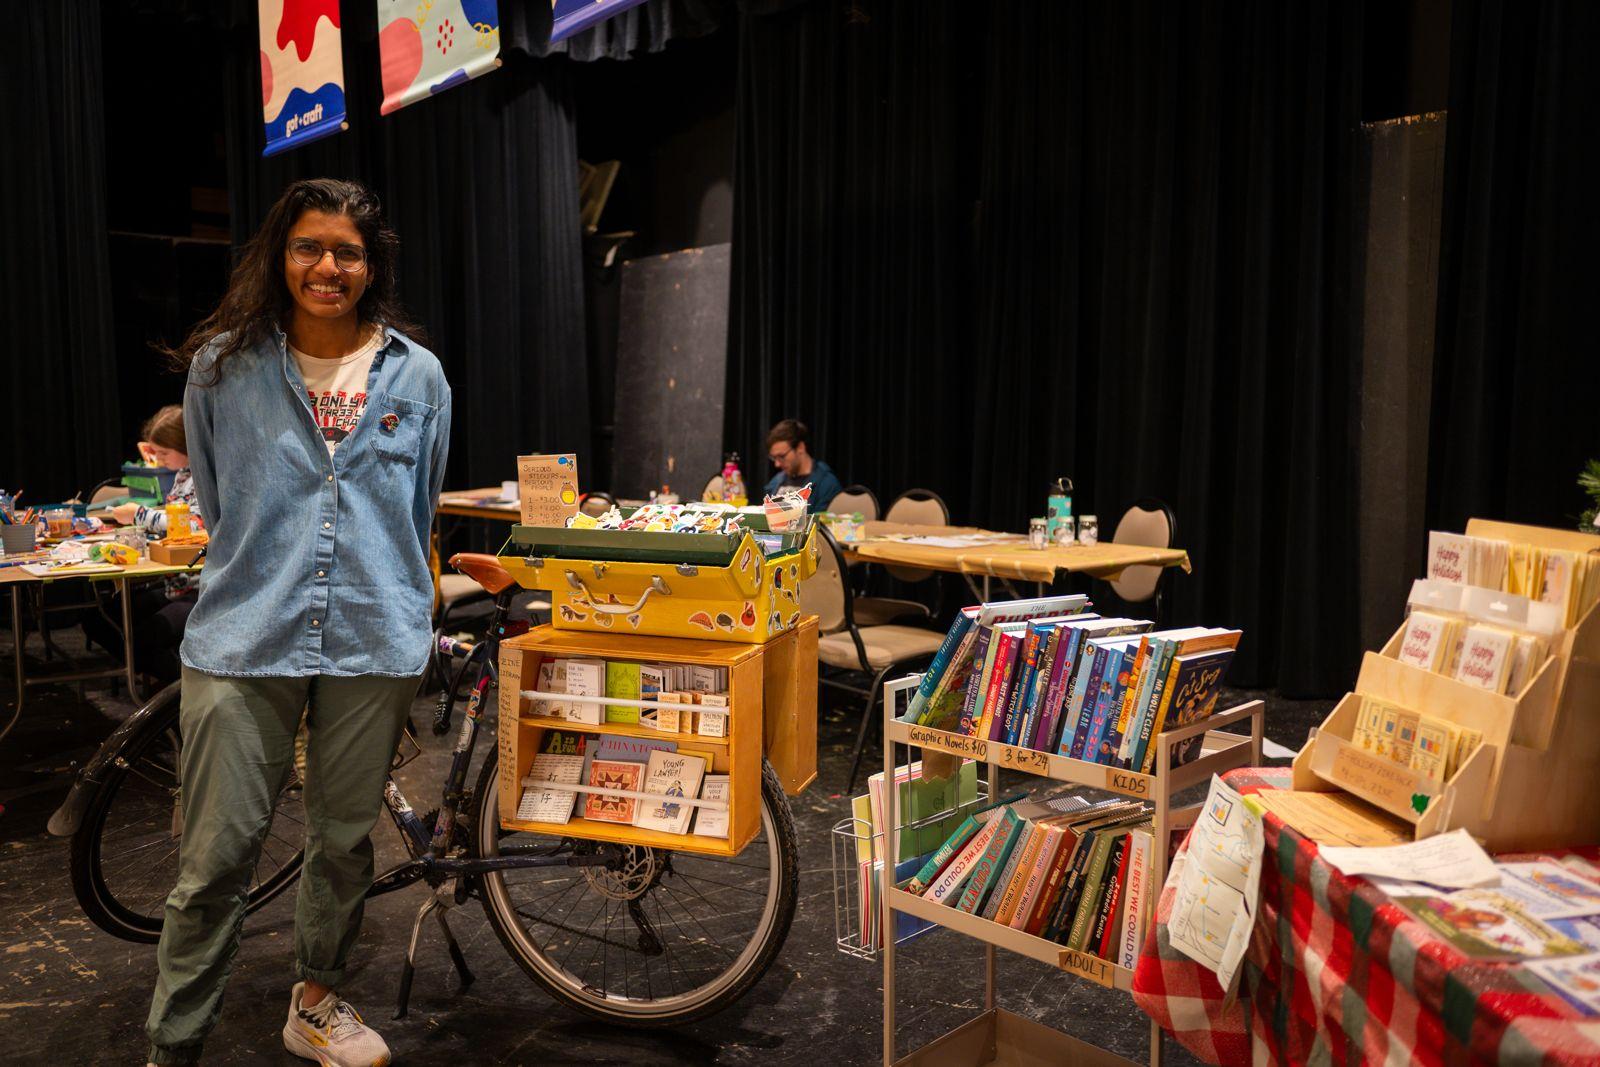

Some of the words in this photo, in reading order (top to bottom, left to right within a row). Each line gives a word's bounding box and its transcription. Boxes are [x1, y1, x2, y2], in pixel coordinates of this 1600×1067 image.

[286, 114, 298, 138] got
[303, 103, 323, 126] craft
[320, 396, 358, 408] ONLY
[523, 464, 551, 472] SERIOUS
[1437, 545, 1460, 566] Happy
[1031, 604, 1047, 612] THE
[1042, 656, 1053, 685] AMULET
[998, 681, 1007, 696] BEST
[1153, 678, 1163, 692] MR.
[1176, 679, 1197, 708] Cat
[994, 695, 1004, 717] FRIENDS
[1007, 690, 1018, 712] WITCH
[1146, 692, 1159, 718] WOLF'S
[1003, 713, 1012, 730] BOY
[1079, 707, 1091, 728] LEAK
[1084, 703, 1108, 759] TWINS
[1140, 718, 1152, 741] CLASS
[546, 732, 562, 754] A
[562, 744, 577, 753] FOR
[910, 730, 942, 747] Graphic
[944, 735, 970, 750] Novels
[971, 738, 987, 757] $10
[663, 759, 685, 769] YOUNG
[1005, 748, 1012, 761] 3
[1017, 750, 1029, 763] for
[1030, 752, 1048, 770] $24
[653, 768, 682, 777] LAWYER!
[1113, 774, 1146, 793] KIDS
[971, 833, 990, 853] BEST
[981, 818, 1017, 864] ESSEX
[963, 850, 976, 863] WE
[1134, 847, 1143, 867] THE
[942, 860, 967, 887] COULD
[1131, 869, 1141, 893] BEST
[933, 884, 946, 898] DO
[955, 860, 996, 914] COUNTY
[1080, 884, 1093, 906] BURMA
[1101, 874, 1118, 913] Cyclopedia
[999, 891, 1014, 915] VAGRANT
[1014, 896, 1028, 920] VAGRANT
[1129, 896, 1138, 911] WE
[1069, 907, 1087, 944] CHRONICLES
[1094, 914, 1108, 939] Exotica
[1125, 914, 1136, 951] COULD
[1064, 952, 1109, 981] ADULT
